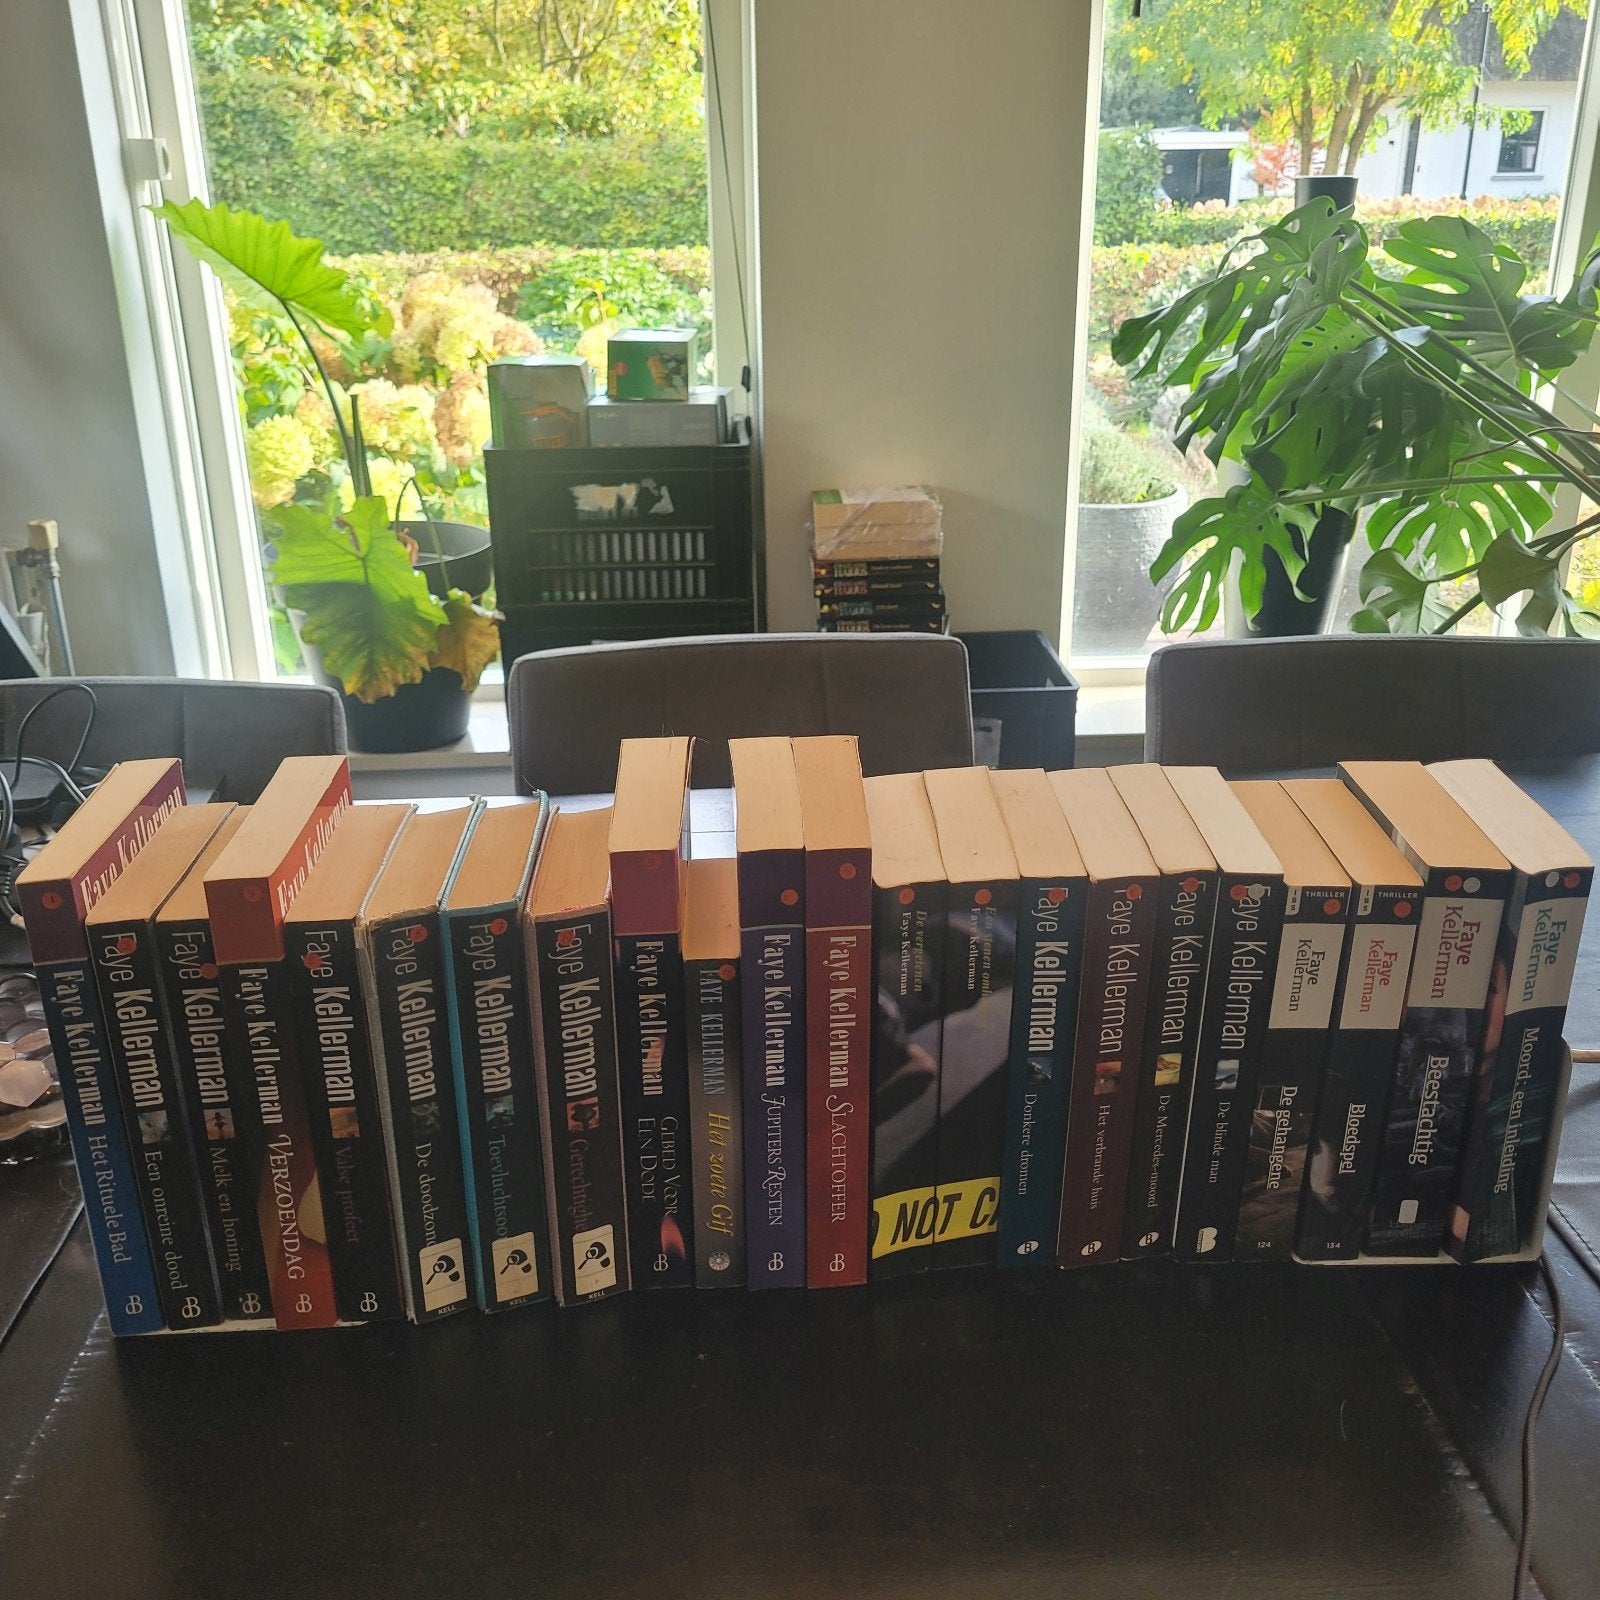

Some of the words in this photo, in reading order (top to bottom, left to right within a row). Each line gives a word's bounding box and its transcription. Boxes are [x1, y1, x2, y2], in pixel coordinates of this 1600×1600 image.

[901, 912, 912, 938] Faye
[916, 910, 928, 929] De
[970, 908, 980, 934] Faye
[1032, 887, 1069, 932] Faye
[1171, 880, 1206, 926] Faye
[99, 931, 138, 982] Faye
[169, 931, 205, 980] Faye
[301, 930, 339, 979] Faye
[387, 924, 421, 975] Faye
[463, 922, 497, 971] Faye
[548, 924, 591, 975] Faye
[630, 941, 664, 987] Faye
[758, 934, 791, 980] Faye
[823, 935, 857, 981] Faye
[900, 940, 911, 996] Kellerman
[967, 935, 979, 990] Kellerman
[1305, 951, 1325, 985] Faye
[1431, 905, 1463, 999] Kellerman
[1455, 921, 1481, 965] Faye
[1523, 908, 1552, 1002] Kellerman
[1543, 920, 1567, 965] Faye
[51, 969, 86, 1018] Faye
[234, 967, 269, 1015] Faye
[700, 969, 723, 1004] FAYE
[1161, 935, 1204, 1044] Kellerman
[1288, 939, 1312, 1012] Kellerman
[1360, 940, 1384, 1012] Kellerman
[1377, 951, 1397, 986] Faye
[1029, 941, 1069, 1052] Kellerman
[1100, 943, 1141, 1054] Kellerman
[1220, 941, 1268, 1050] Kellerman
[113, 988, 164, 1107] Kellerman
[182, 988, 230, 1103] Kellerman
[312, 986, 357, 1103] Kellerman
[397, 979, 437, 1101] Kellerman
[473, 975, 514, 1093] Kellerman
[558, 977, 602, 1097] Kellerman
[638, 993, 668, 1096] Kellerman
[701, 1013, 726, 1096] KELLERMAN
[764, 985, 792, 1087] Kellerman
[829, 987, 857, 1088] Kellerman
[65, 1022, 107, 1126] Kellerman
[247, 1021, 284, 1126] Kellerman
[1279, 1085, 1298, 1107] De
[1021, 1094, 1037, 1146] Donkere
[1098, 1104, 1110, 1126] Het
[1158, 1094, 1171, 1112] De
[1217, 1101, 1231, 1119] De
[1408, 1055, 1449, 1165] Beestachtig
[1508, 1090, 1526, 1120] een
[87, 1134, 109, 1165] Het
[708, 1111, 731, 1147] Het
[761, 1093, 786, 1165] JUPITERS
[1212, 1120, 1228, 1158] blinde
[1267, 1109, 1293, 1190] gehangene
[1339, 1103, 1366, 1174] Bloedspel
[144, 1151, 163, 1186] Een
[210, 1147, 233, 1188] Melk
[415, 1143, 432, 1168] De
[709, 1152, 729, 1199] zoete
[826, 1094, 854, 1223] SLACHTOFFER
[1018, 1150, 1036, 1195] dromen
[1092, 1129, 1108, 1185] verbrande
[1208, 1161, 1219, 1183] man
[1494, 1123, 1522, 1194] inleiding
[94, 1168, 120, 1229] Rituele
[219, 1193, 233, 1212] en
[268, 1133, 305, 1281] VERZOENDAG
[488, 1134, 511, 1240] Toevluchtsoo
[762, 1166, 787, 1226] RESTEN
[150, 1188, 174, 1246] onreine
[706, 1203, 733, 1237] Gif
[890, 1193, 962, 1246] NOT
[107, 1231, 132, 1264] Bad
[222, 1215, 242, 1273] honing
[164, 1251, 188, 1291] dood
[588, 1290, 606, 1300] KELL
[438, 1304, 457, 1315] KELL
